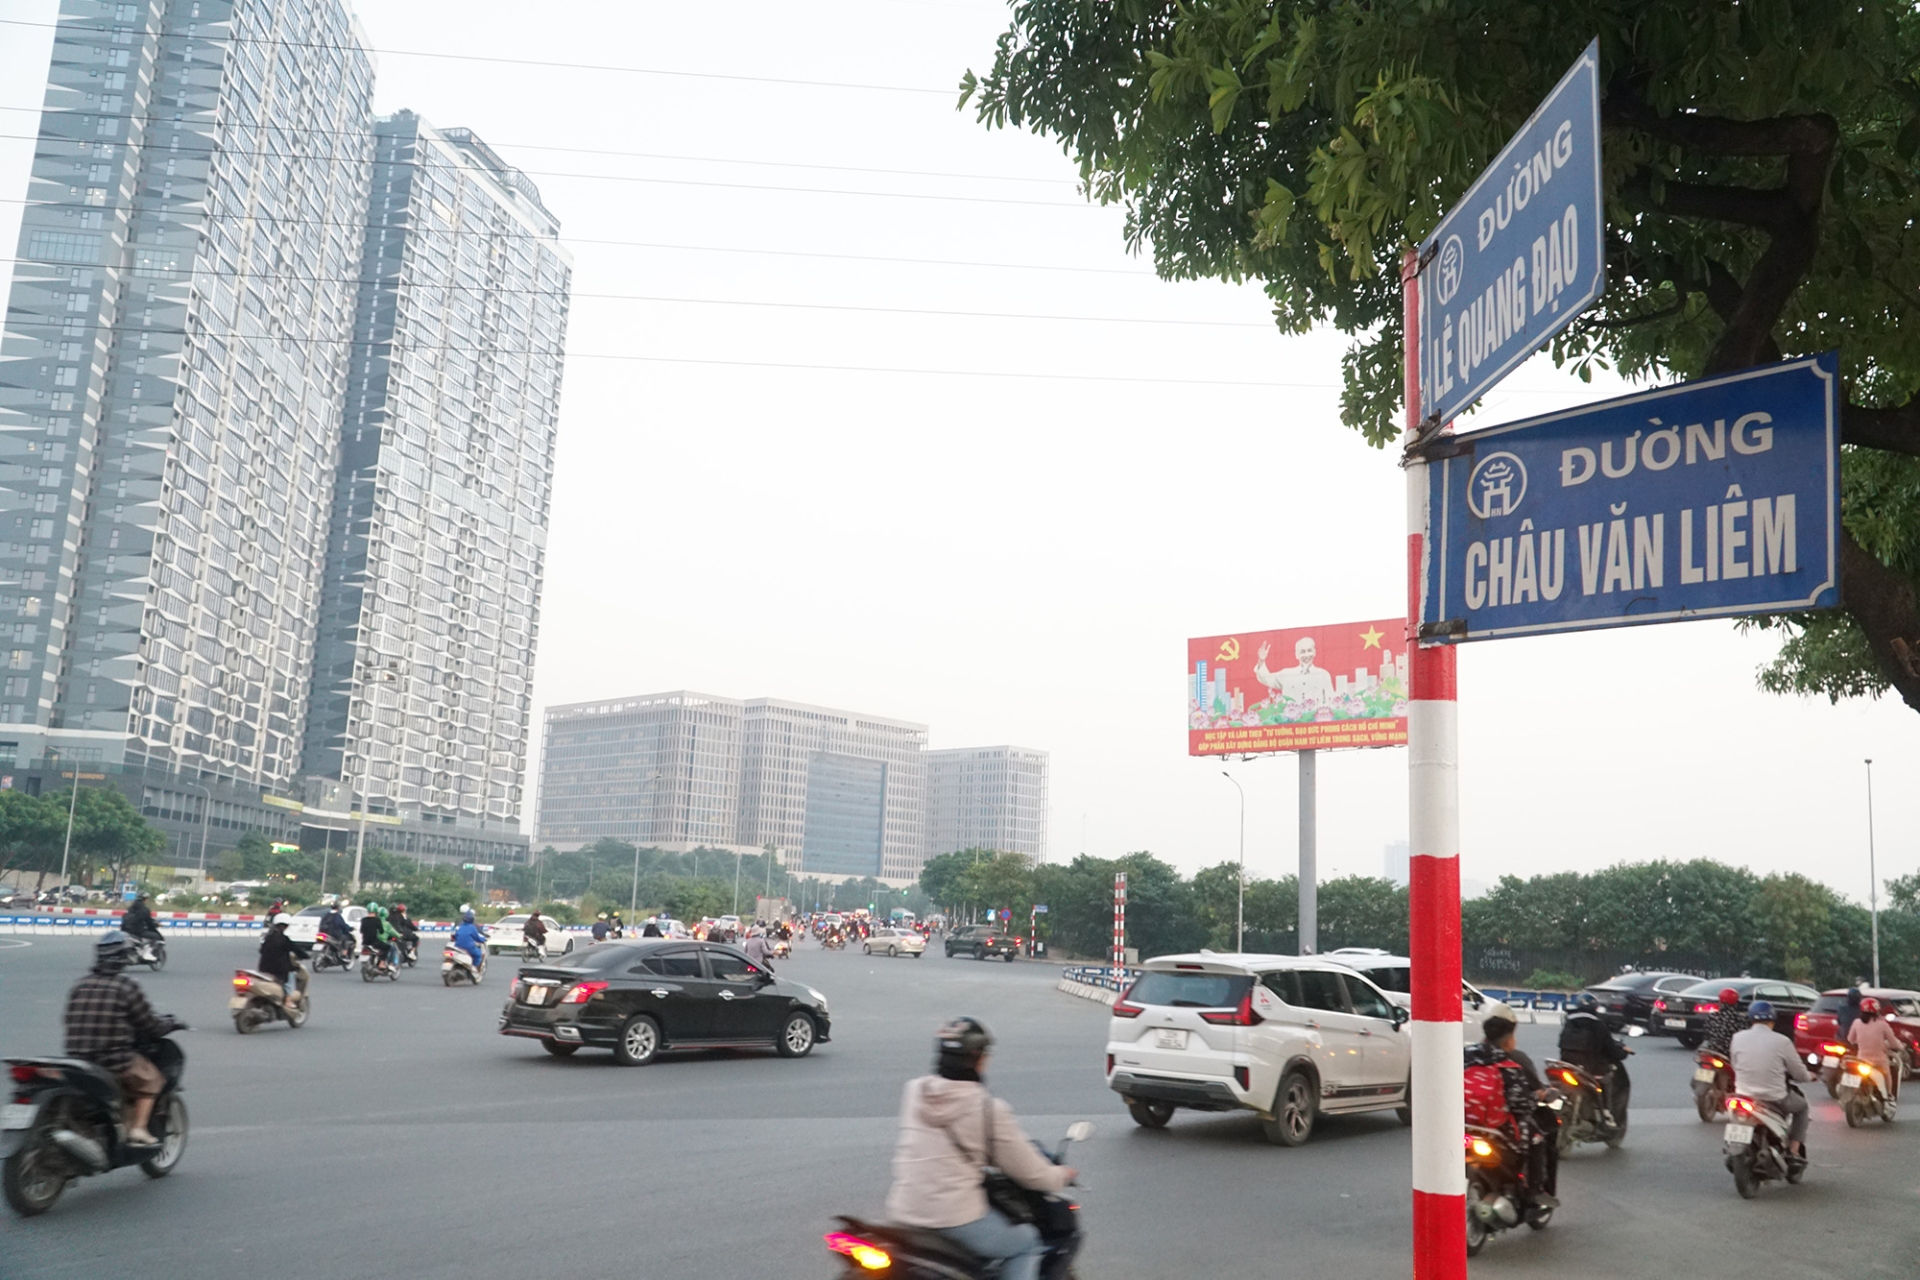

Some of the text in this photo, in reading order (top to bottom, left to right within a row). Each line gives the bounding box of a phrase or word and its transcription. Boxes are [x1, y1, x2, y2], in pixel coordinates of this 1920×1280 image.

[1477, 119, 1573, 252] ĐƯỜNG
[1433, 204, 1579, 402] LÊ QUANG ĐẠO
[1558, 411, 1774, 487] ĐƯỜNG
[1465, 483, 1797, 610] CHÂU VĂN LIÊM
